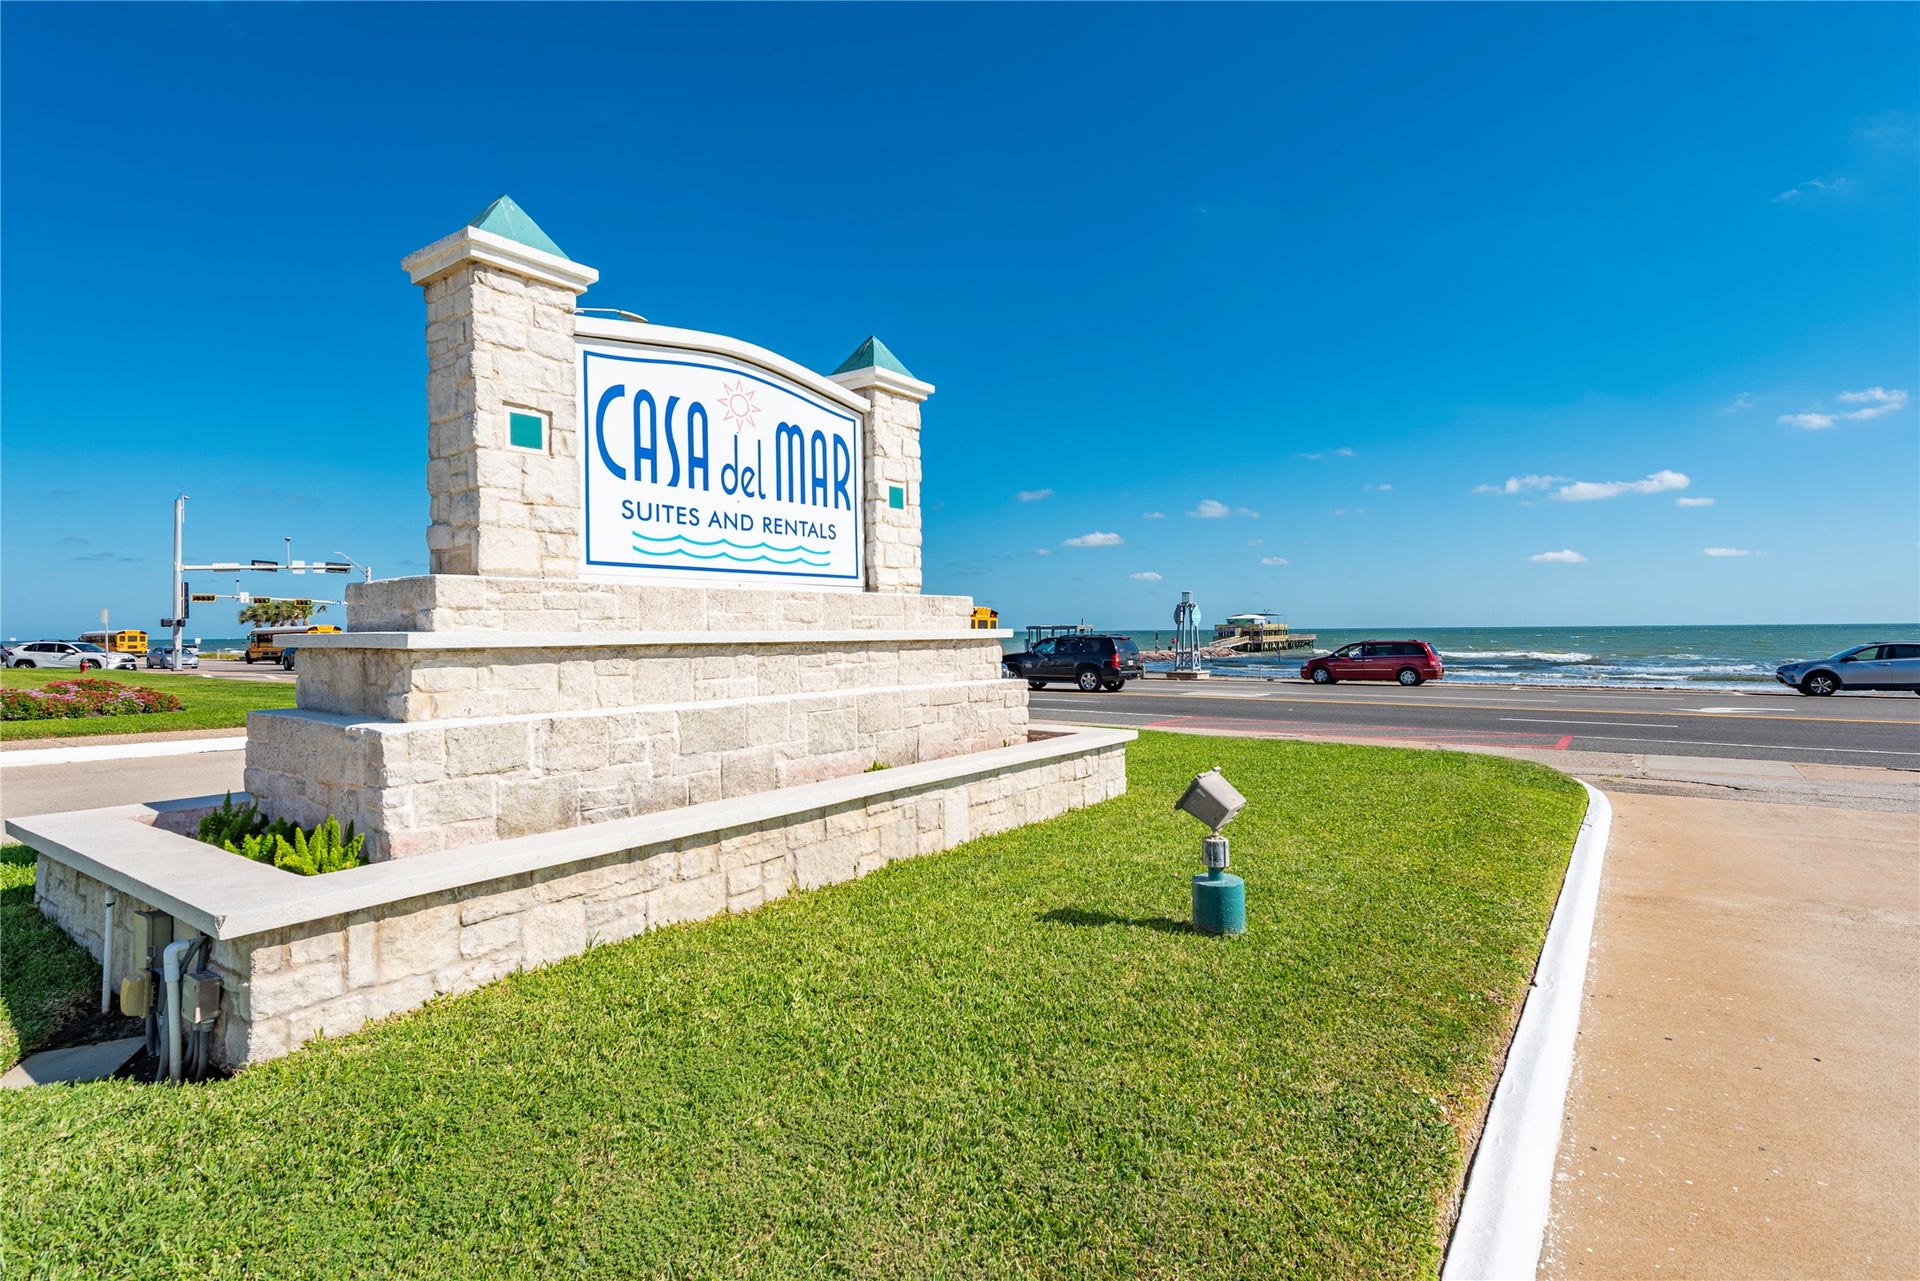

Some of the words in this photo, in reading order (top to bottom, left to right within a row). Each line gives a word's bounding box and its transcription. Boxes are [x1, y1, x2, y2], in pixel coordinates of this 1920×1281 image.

[596, 384, 709, 491] CASA
[720, 434, 766, 500] del
[775, 421, 851, 511] MAR
[621, 499, 700, 526] SUITES
[708, 509, 754, 531] AND
[762, 516, 837, 540] RENTALS
